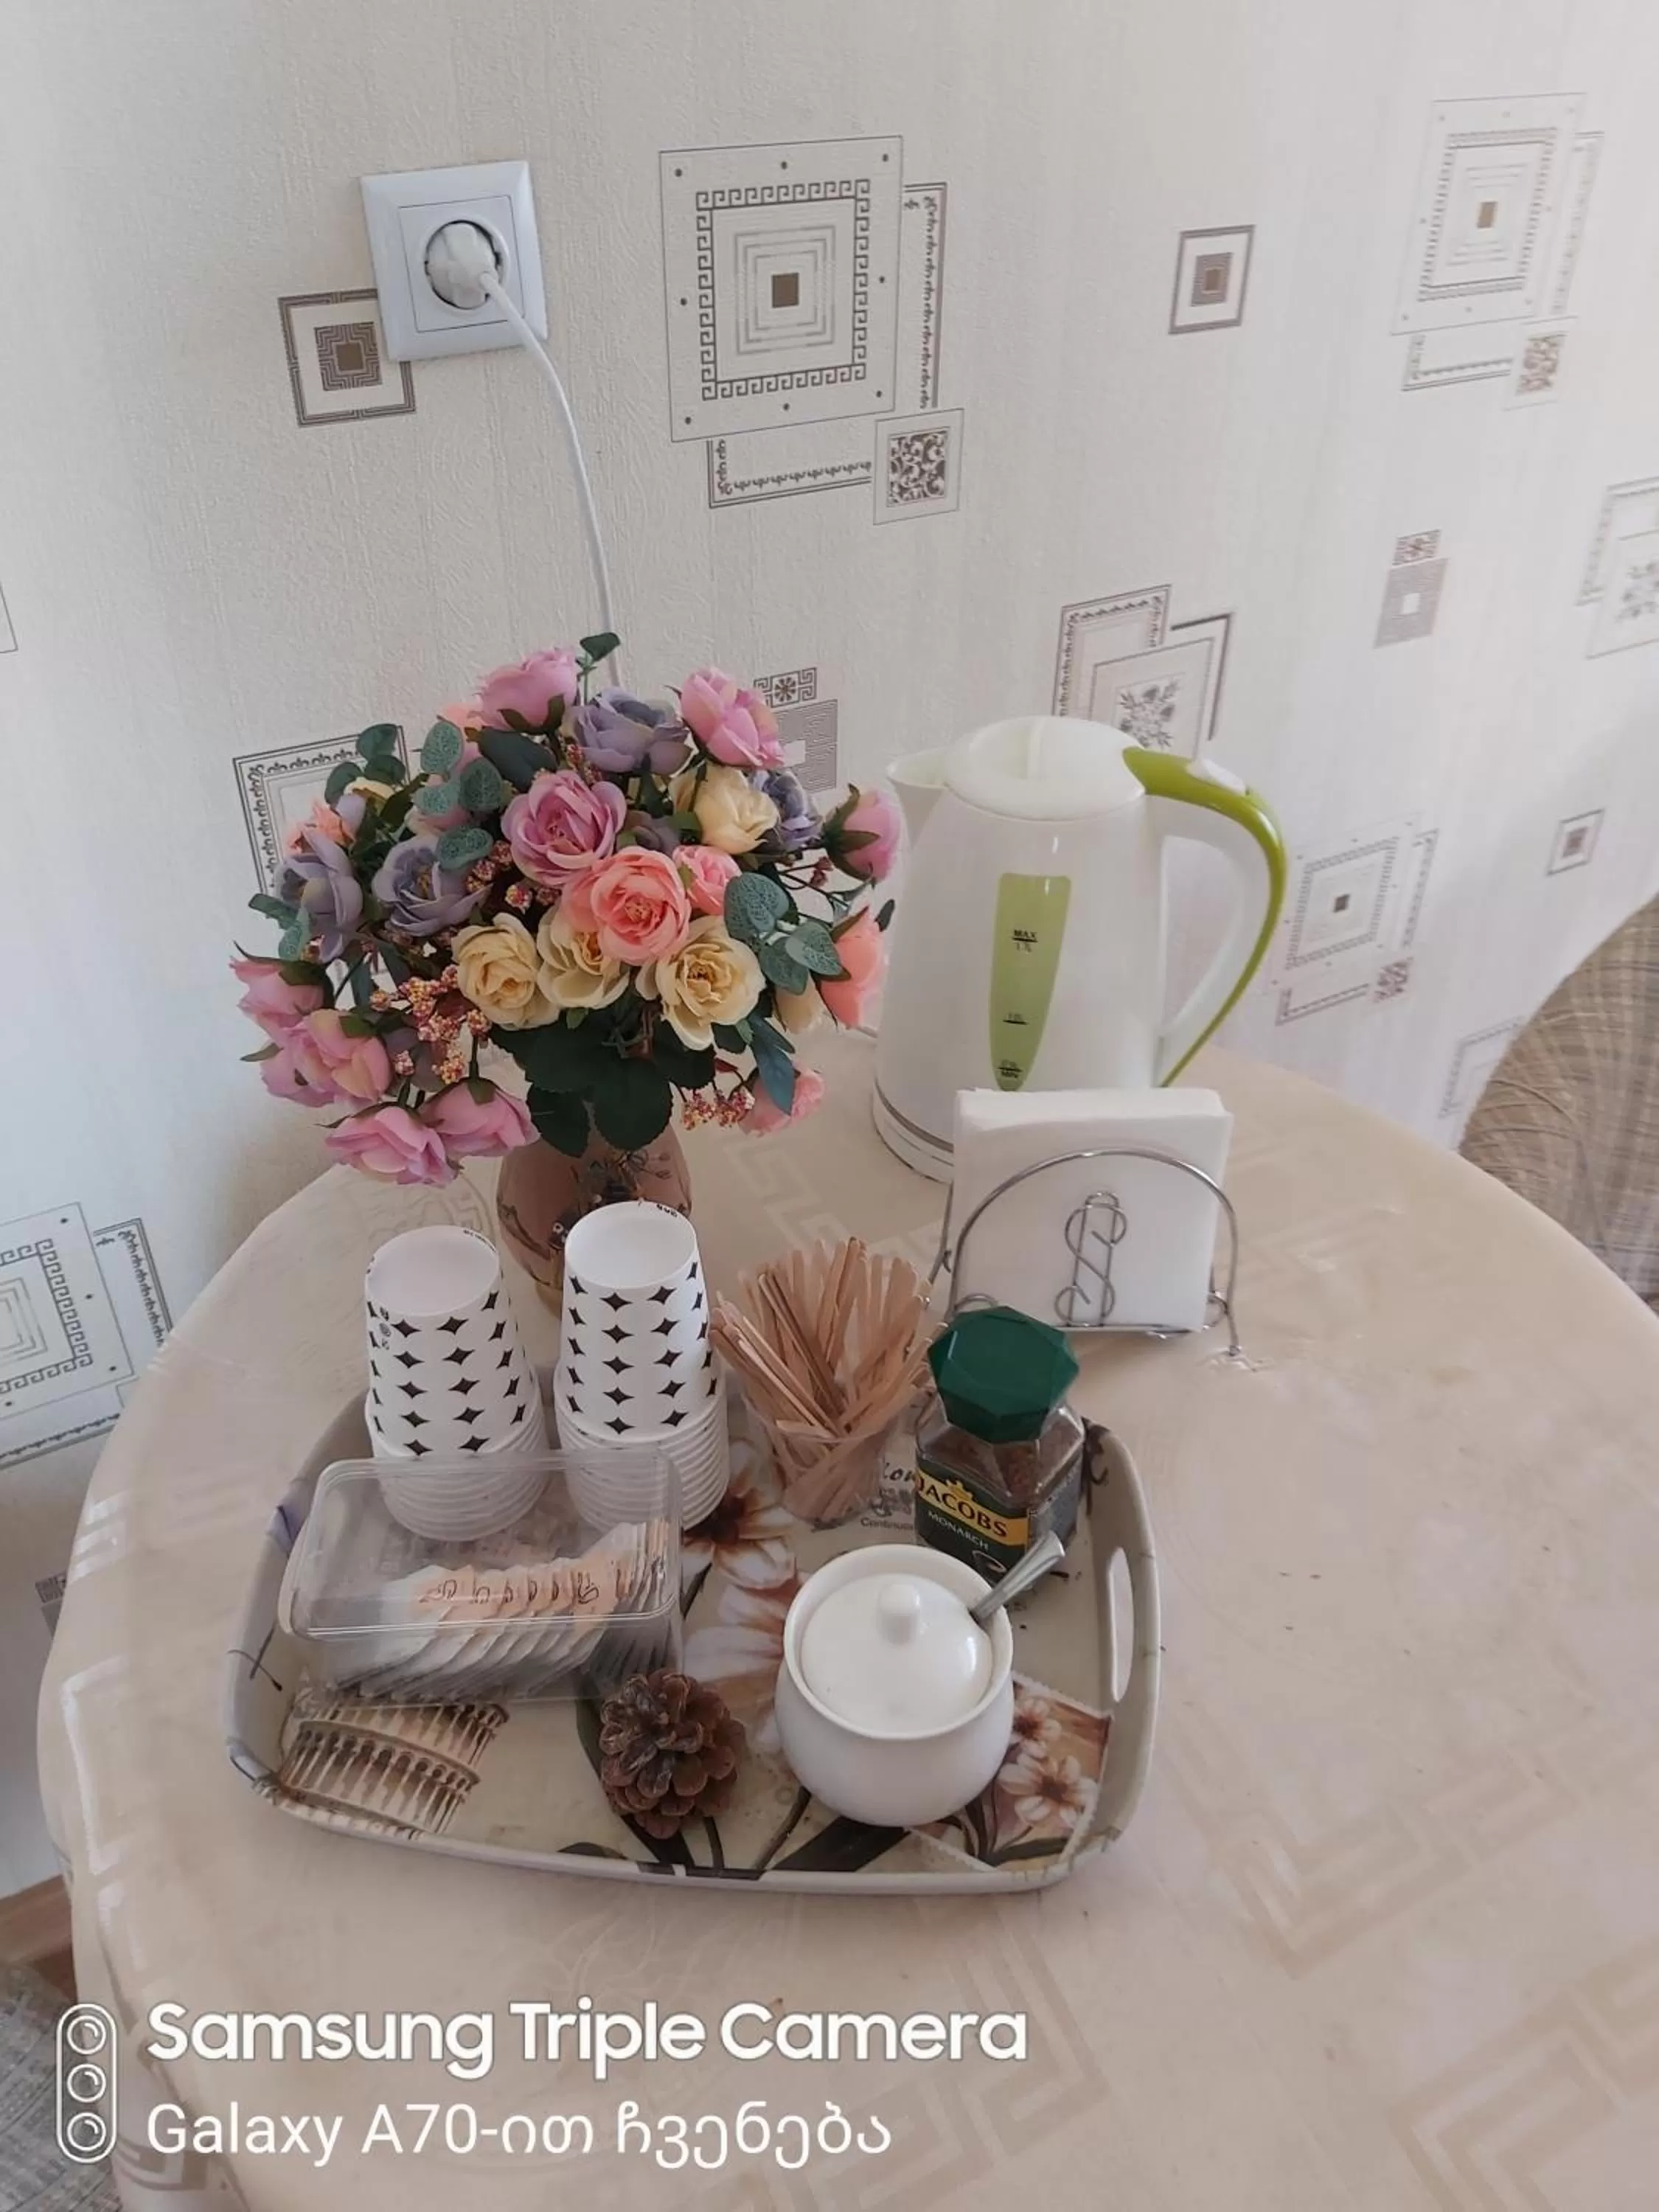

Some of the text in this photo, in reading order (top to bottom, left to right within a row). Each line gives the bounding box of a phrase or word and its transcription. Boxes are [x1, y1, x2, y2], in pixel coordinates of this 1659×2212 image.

[1014, 929, 1037, 940] MAX
[916, 1475, 1008, 1537] JACOBS
[928, 1510, 990, 1551] MONARCH
